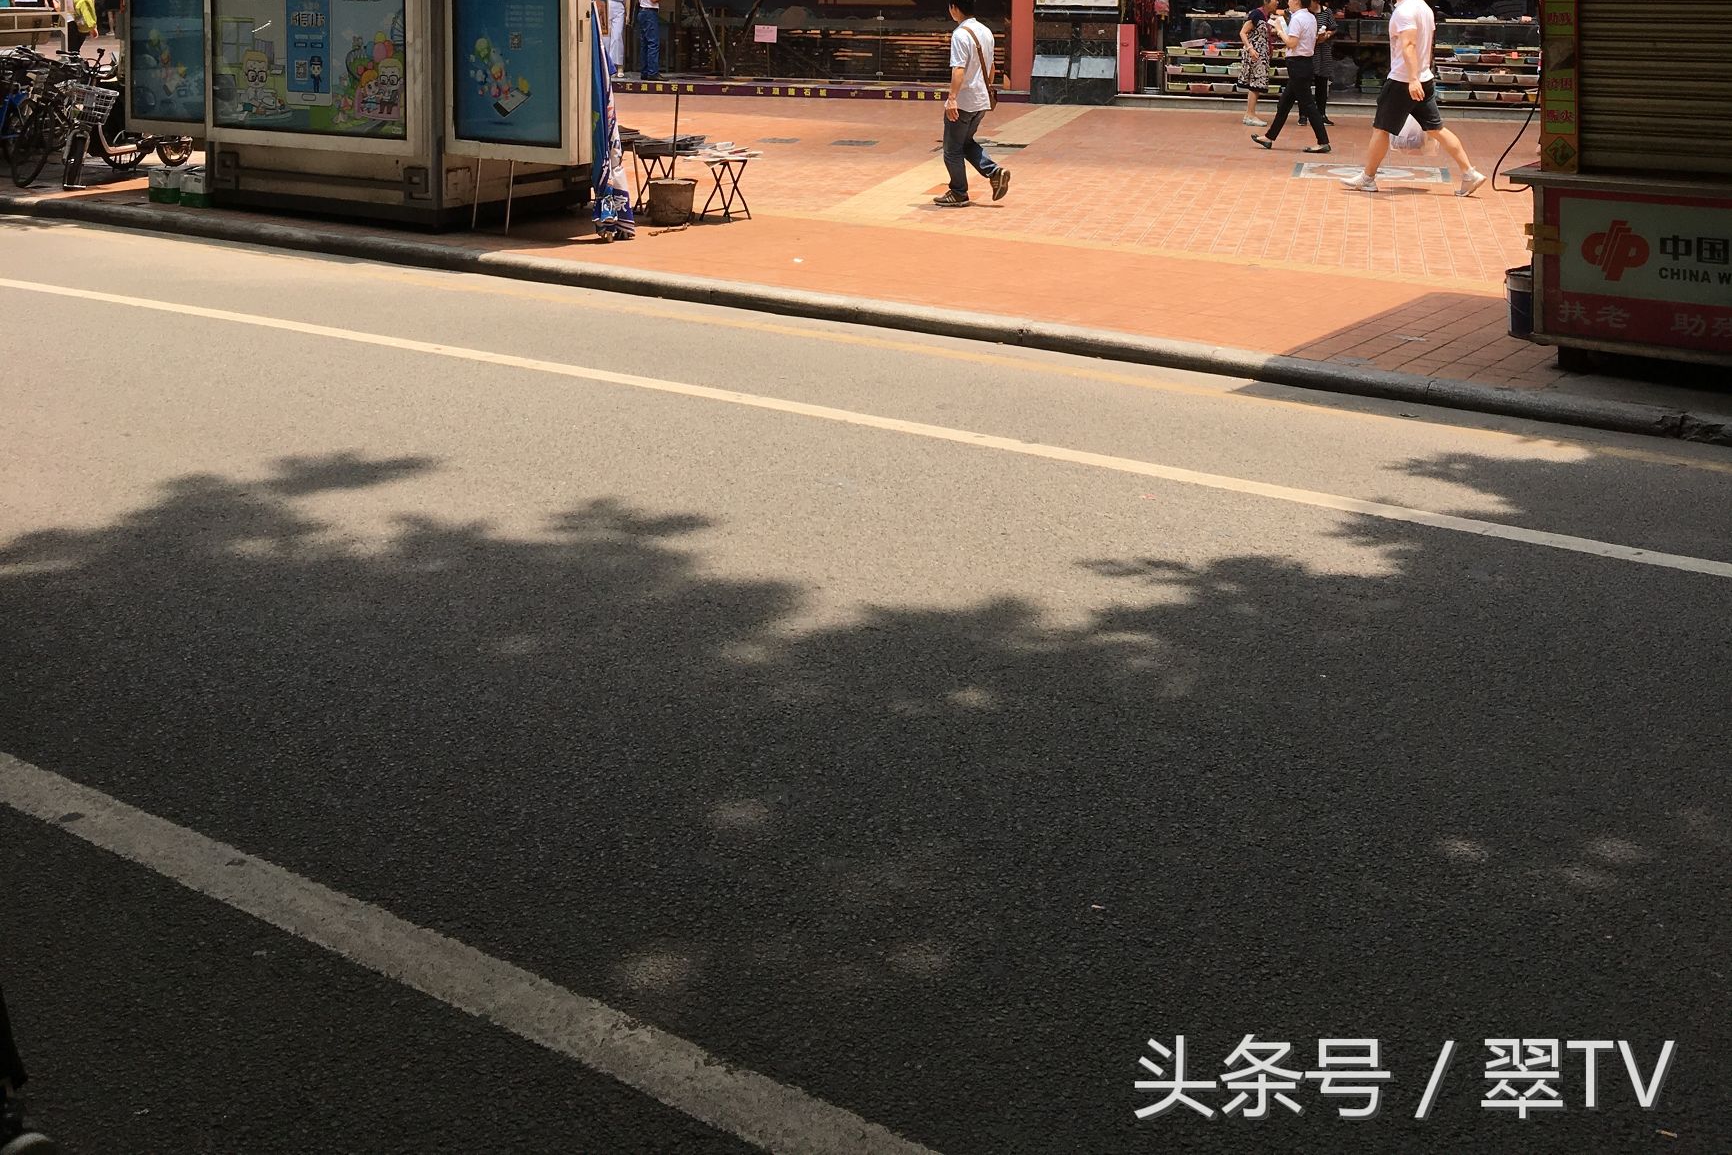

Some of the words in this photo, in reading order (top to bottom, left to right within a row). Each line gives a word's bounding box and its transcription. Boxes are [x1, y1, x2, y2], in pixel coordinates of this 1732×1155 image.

[1660, 234, 1730, 265] 中国
[1658, 267, 1712, 284] CHINA
[1557, 300, 1632, 329] 扶老
